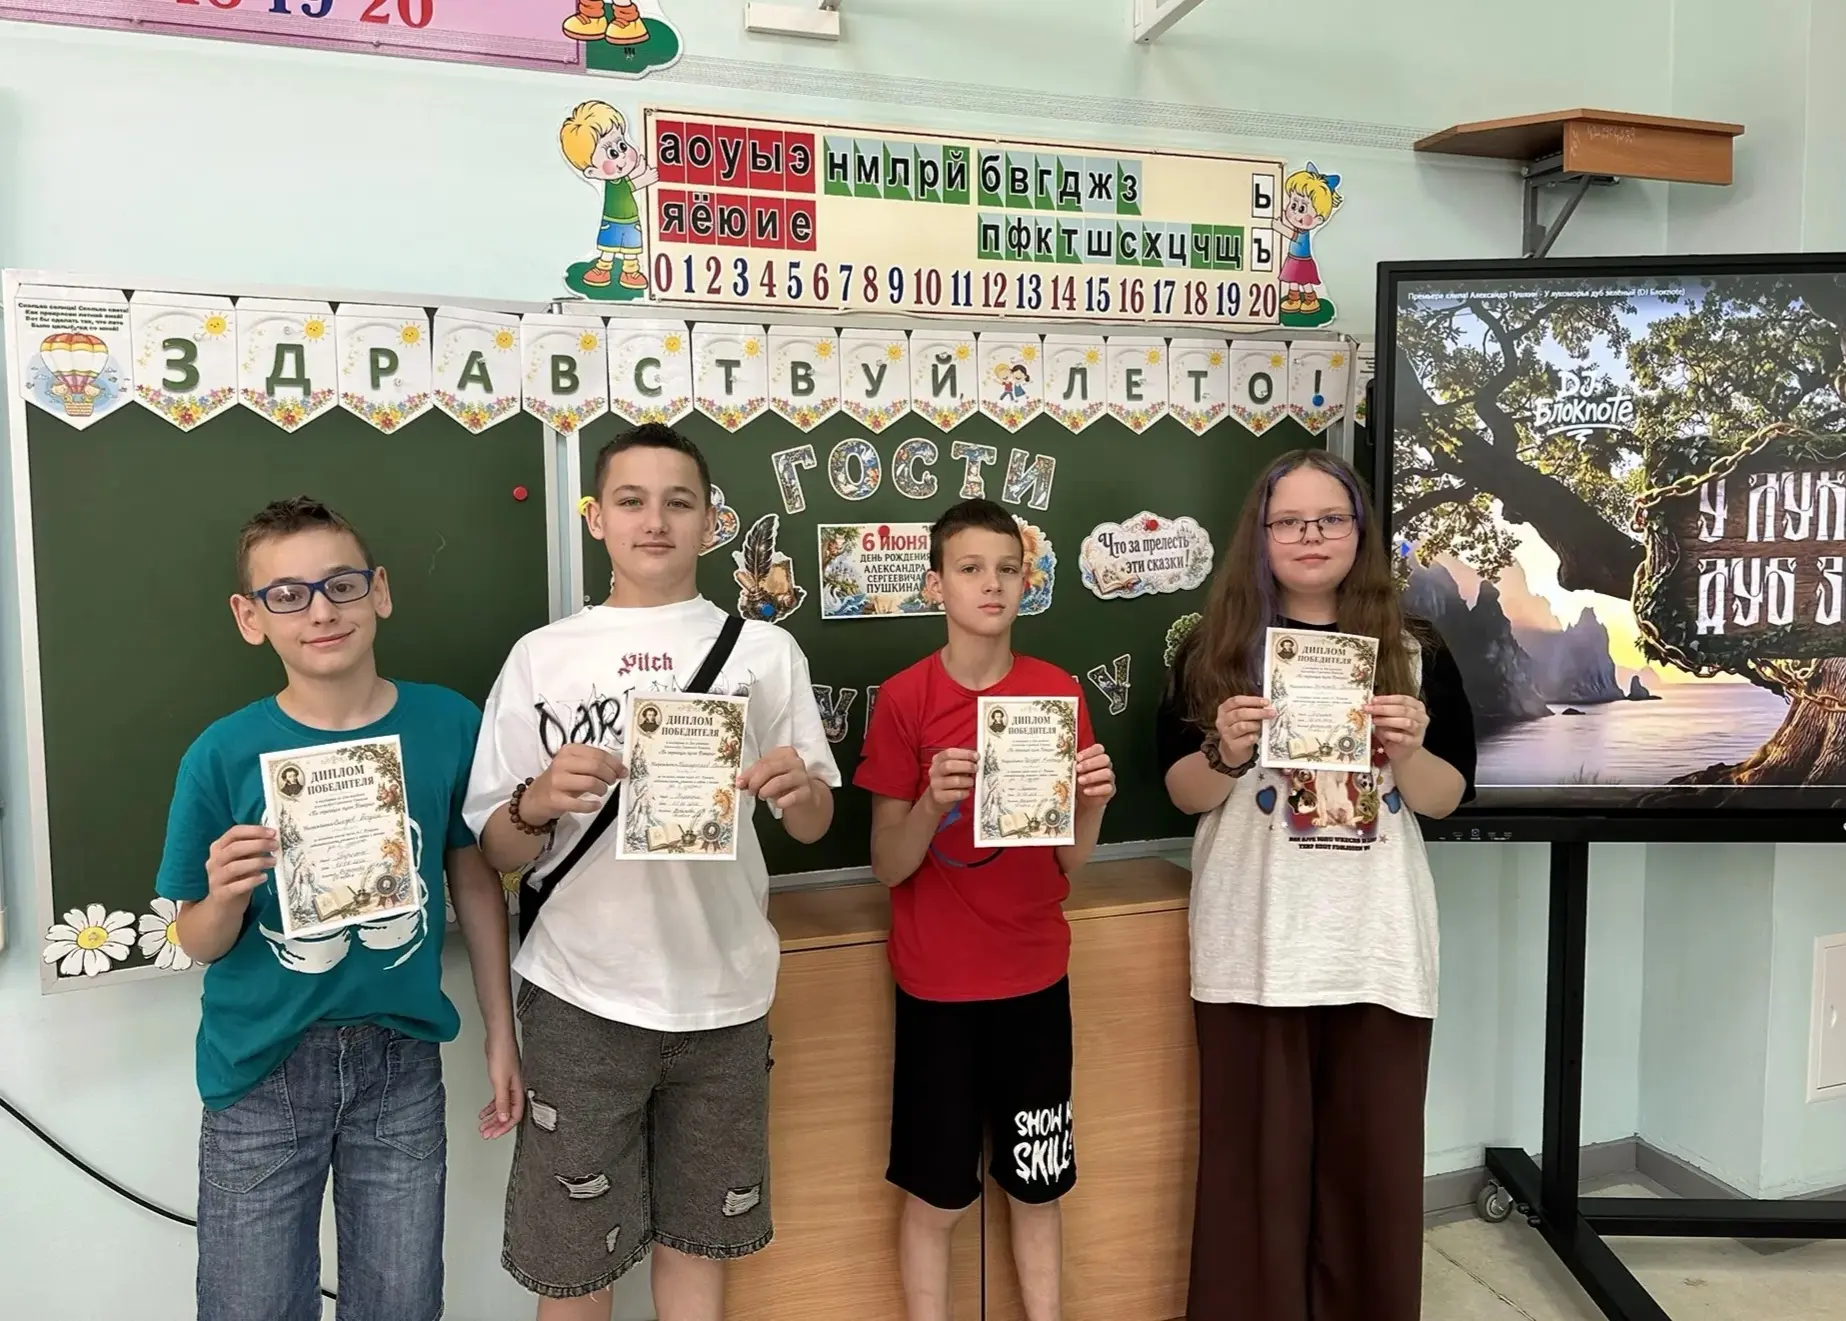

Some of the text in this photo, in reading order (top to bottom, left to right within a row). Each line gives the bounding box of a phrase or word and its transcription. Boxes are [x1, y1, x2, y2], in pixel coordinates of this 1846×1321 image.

[654, 252, 1277, 318] 0 1 2 3 4 5 6 7 8 9 10 11 12 13 14 15 16 17 18 19 20
[1590, 289, 1604, 298] дуб
[1555, 370, 1598, 401] DJ
[771, 437, 1056, 514] ГОСТИ
[1698, 478, 1728, 543] У
[862, 533, 928, 551] 6 ИЮНЯ
[1098, 532, 1189, 558] Что за прелесть
[860, 552, 931, 563] ДЕНЬ РОЖДЕНИЯ
[864, 564, 926, 573] АЛЕКСАНДРА
[1125, 560, 1145, 574] эти
[867, 573, 921, 583] СЕРГЕЕВИЧА
[867, 583, 920, 593] ПУШКИНА
[1695, 557, 1797, 635] ДУБ
[1302, 646, 1346, 656] ДИПЛОМ
[1297, 655, 1352, 664] ПОБЕДИТЕЛЯ
[666, 715, 713, 726] ДИПЛОМ
[1011, 716, 1051, 725] ДИПЛОМ
[661, 727, 719, 737] ПОБЕДИТЕЛЯ
[1008, 727, 1056, 735] ПОБЕДИТЕЛЯ
[311, 765, 364, 784] ДИПЛОМ
[307, 776, 374, 795] ПОБЕДИТЕЛЯ
[1014, 1103, 1062, 1137] SHOW
